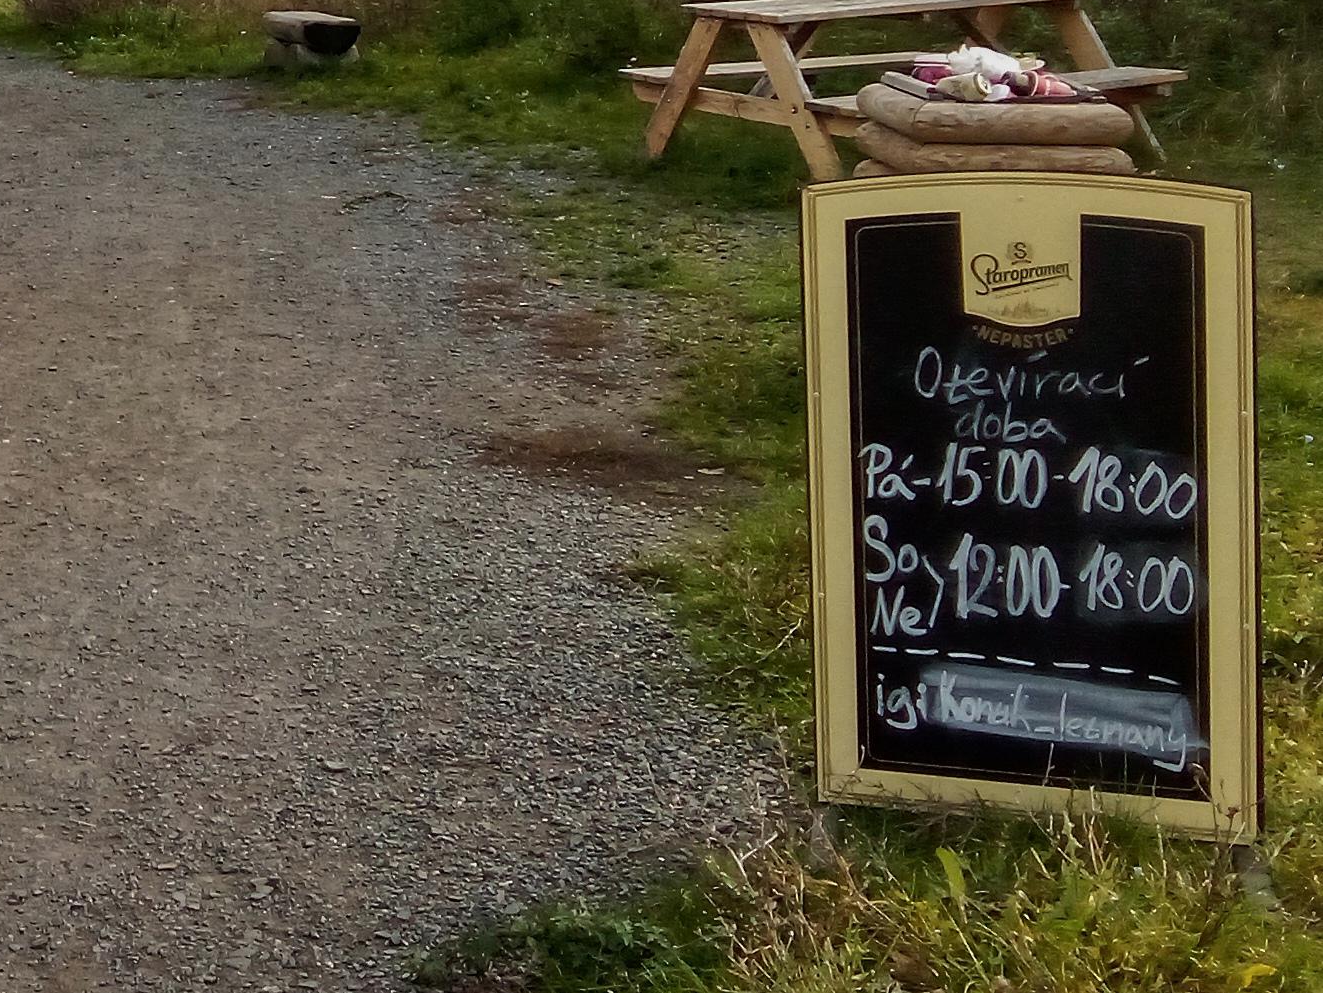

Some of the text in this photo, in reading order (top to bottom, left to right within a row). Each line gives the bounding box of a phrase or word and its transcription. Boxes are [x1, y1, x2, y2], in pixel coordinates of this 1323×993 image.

[970, 252, 1074, 296] Staropramen
[914, 345, 1151, 405] Otevírací
[953, 401, 1068, 444] doba
[869, 585, 929, 637] Ne
